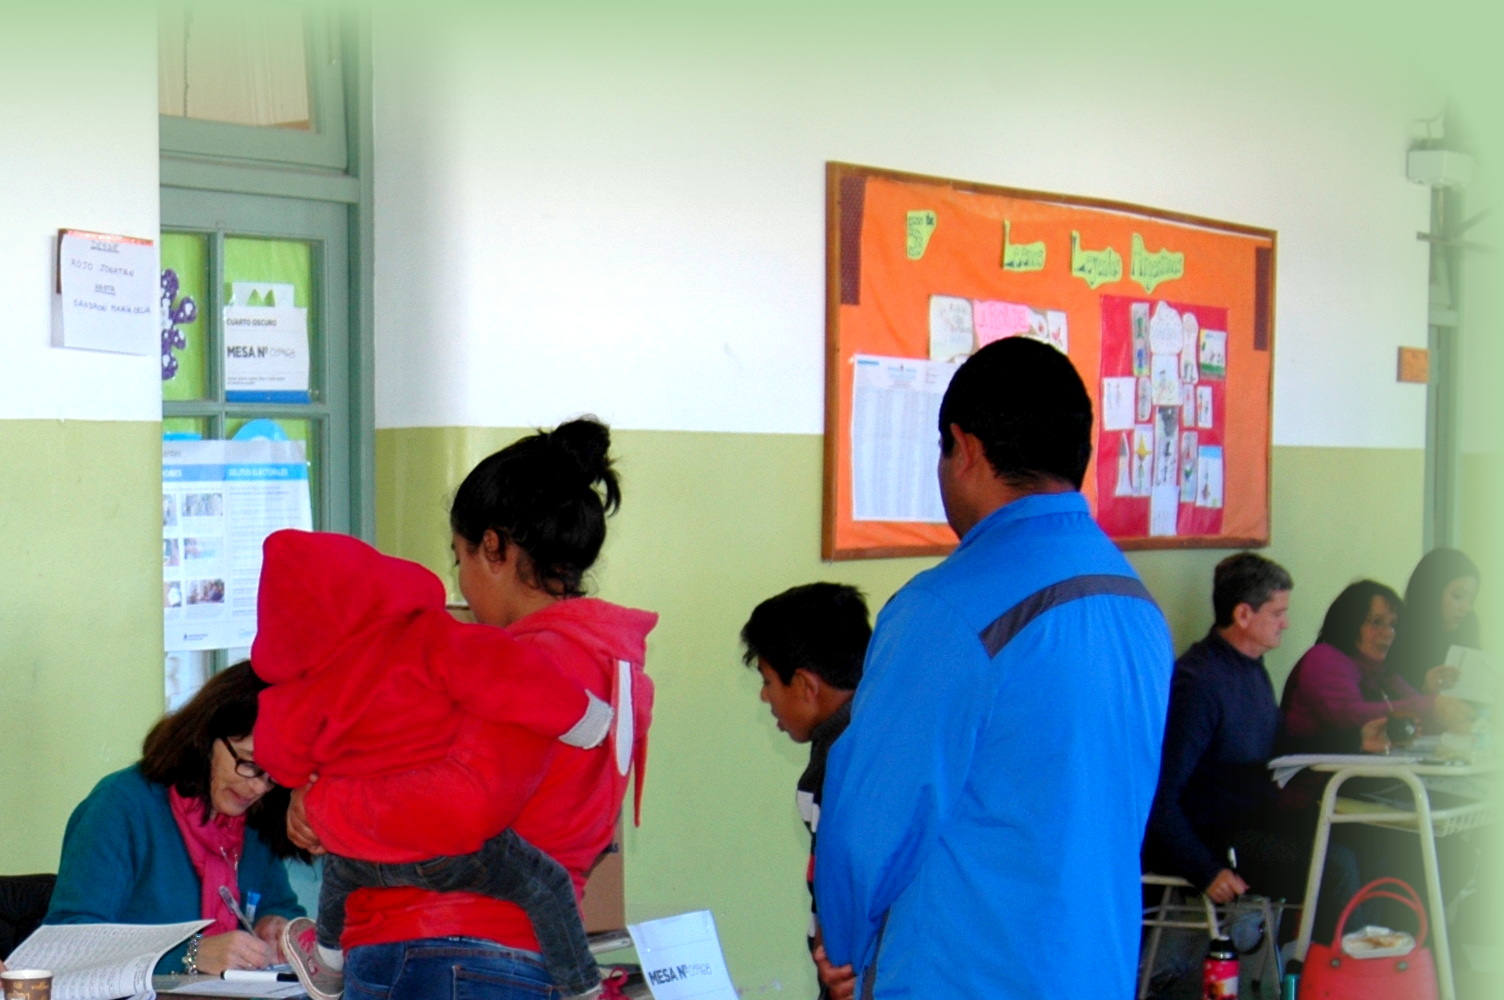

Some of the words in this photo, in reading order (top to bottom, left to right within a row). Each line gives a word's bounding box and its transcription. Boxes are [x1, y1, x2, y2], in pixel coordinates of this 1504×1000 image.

[227, 318, 251, 326] CUARTO
[252, 318, 277, 326] OSCURO
[227, 346, 255, 358] MESA
[648, 966, 678, 986] MESA
